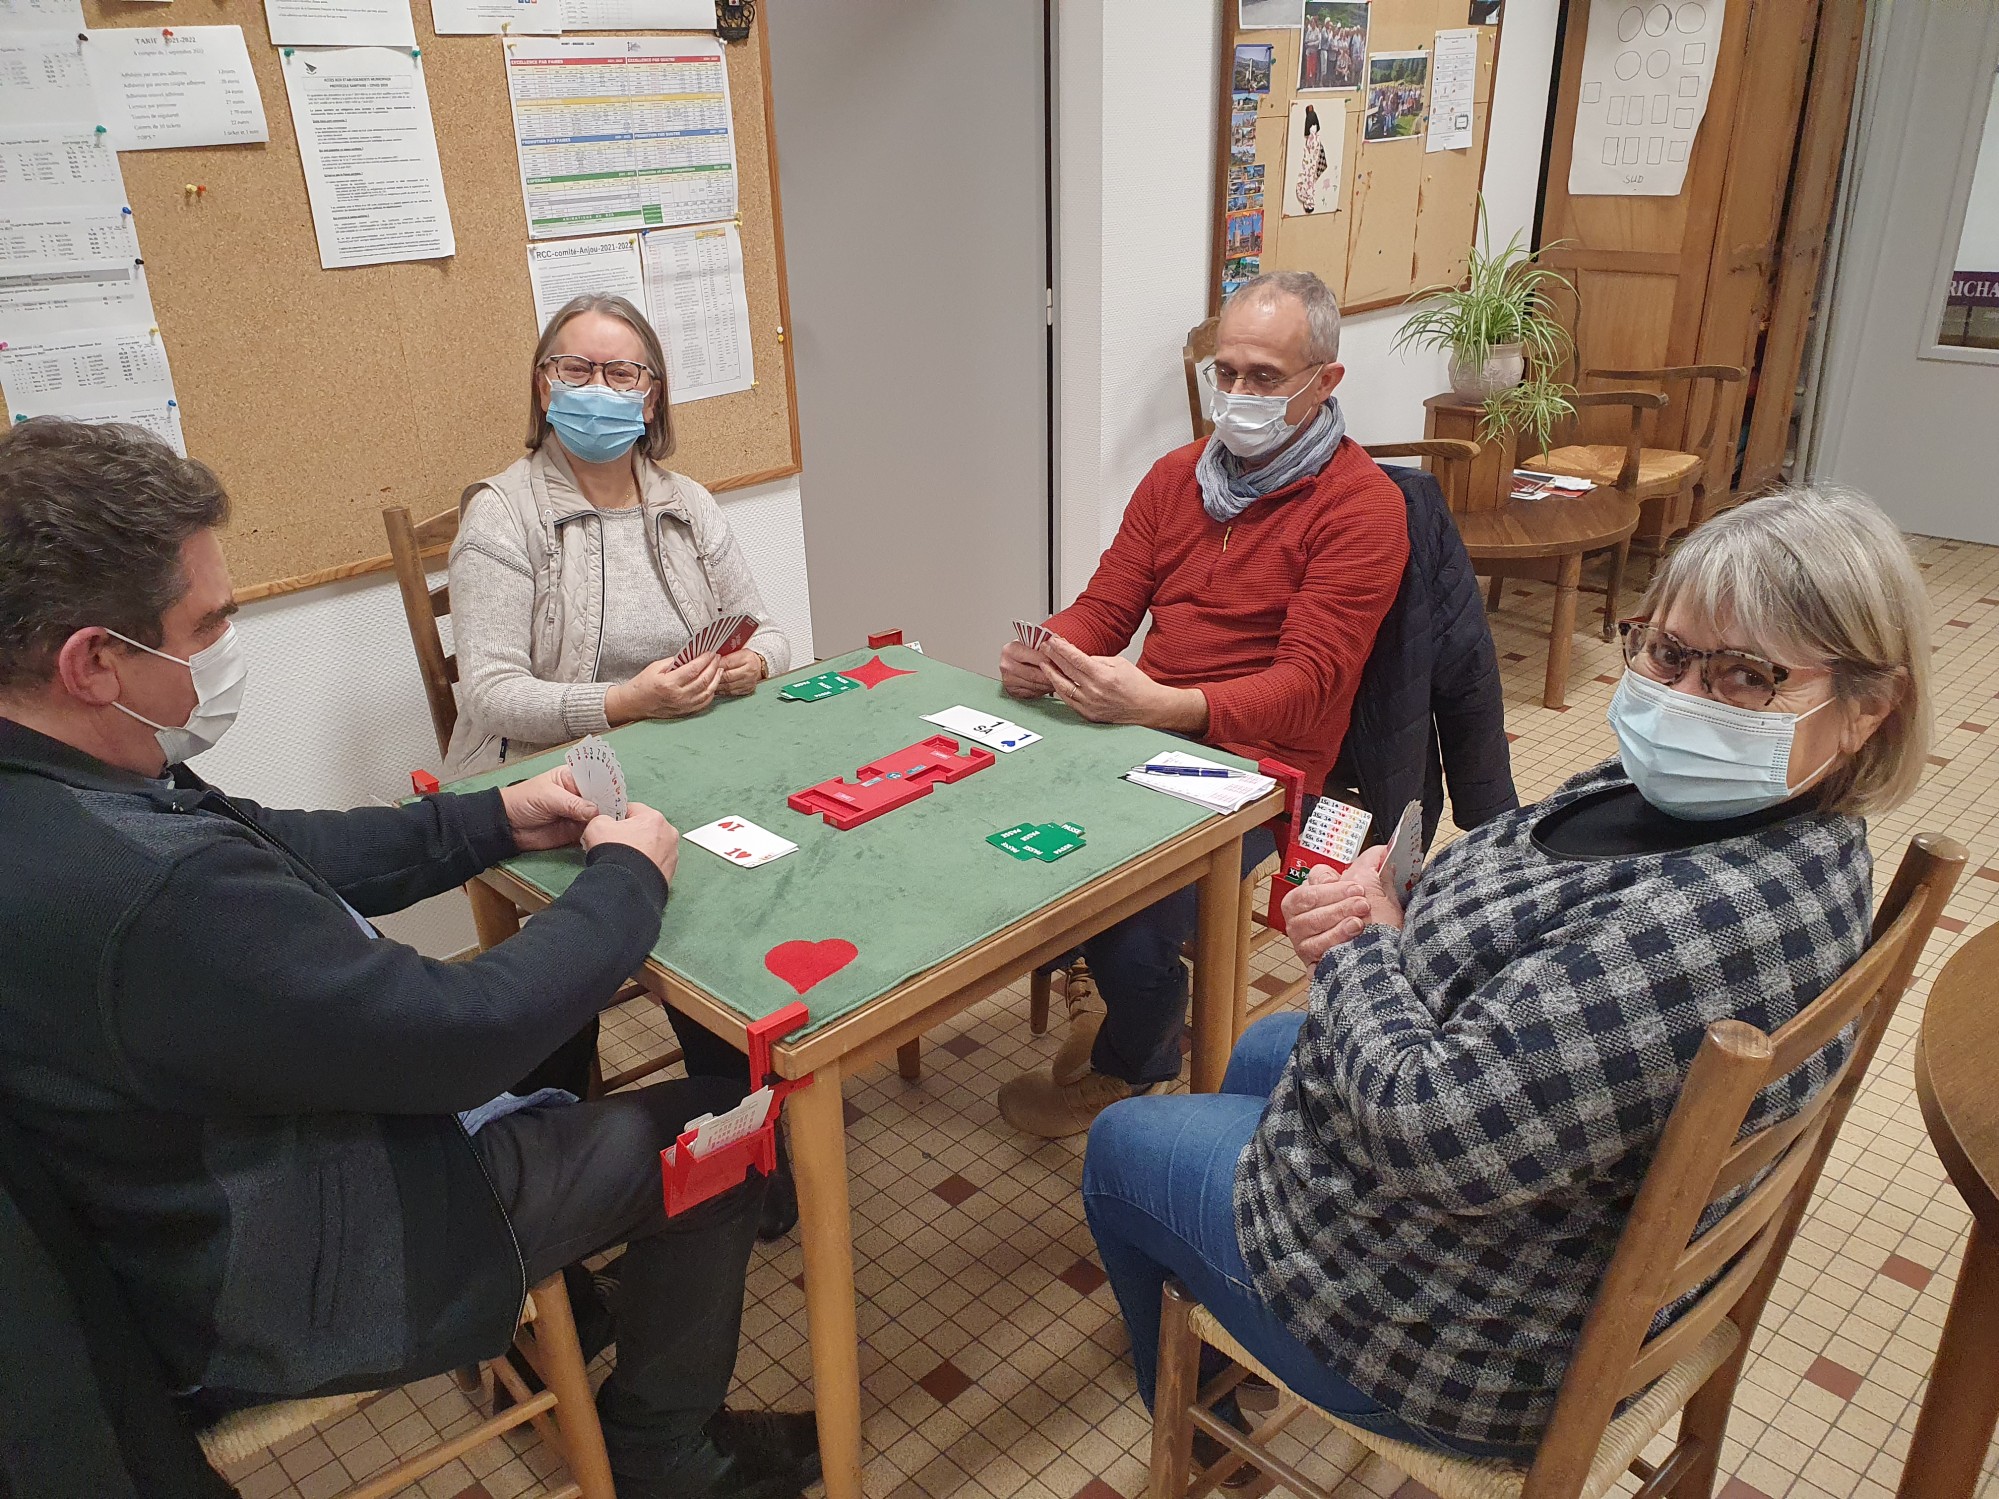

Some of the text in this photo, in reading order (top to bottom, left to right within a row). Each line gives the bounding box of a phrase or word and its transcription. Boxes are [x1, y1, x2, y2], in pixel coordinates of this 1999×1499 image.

[1622, 175, 1644, 184] SUD
[973, 725, 993, 734] SA
[727, 823, 745, 832] 1
[724, 848, 742, 856] 1
[1289, 868, 1300, 878] XX
